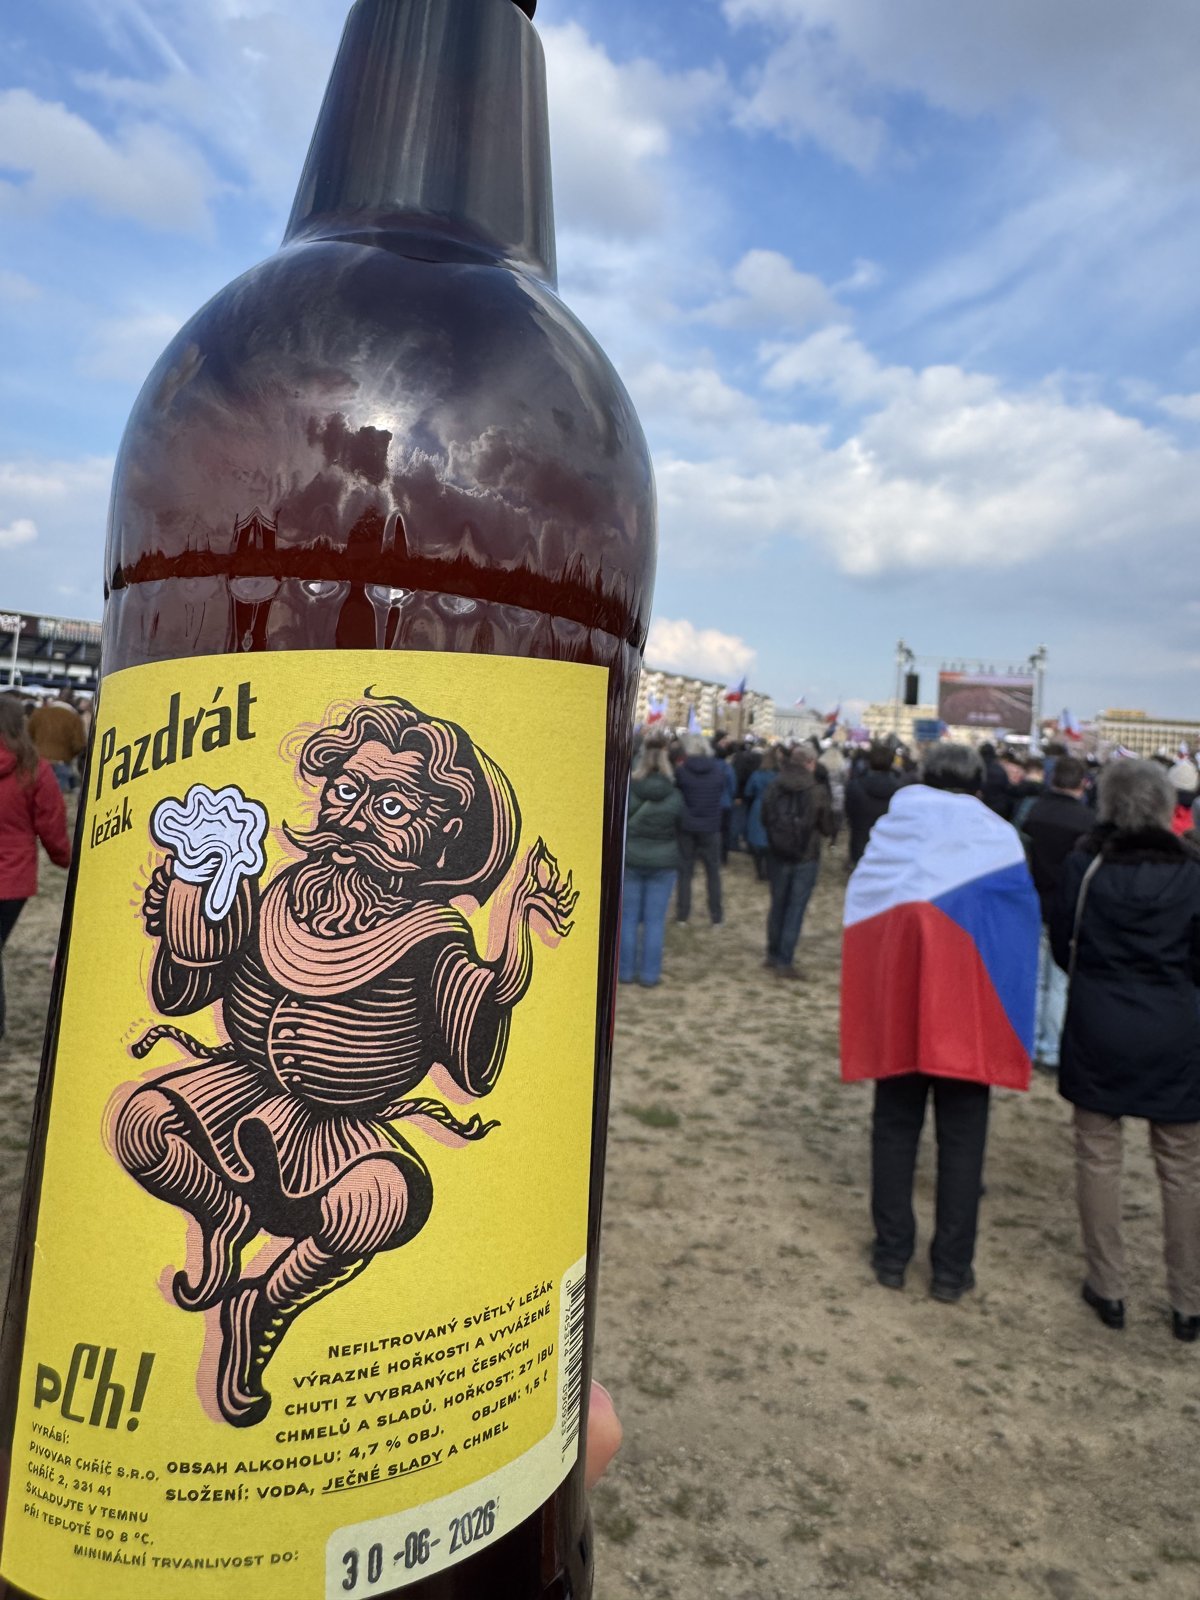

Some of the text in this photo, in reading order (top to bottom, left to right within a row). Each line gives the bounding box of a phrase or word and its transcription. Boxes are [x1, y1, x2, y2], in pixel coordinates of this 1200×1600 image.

[96, 681, 257, 800] Pazdrát
[90, 797, 133, 849] ležák
[293, 1300, 550, 1388] VÝRAZNÉ HOŘKOSTI A VYVÁŽENÉ
[328, 1280, 553, 1358] NEFILTROVANÝ SVĚTLÝ LEŽÁK
[275, 1344, 554, 1443] CHMELŮ A SLADŮ. HOŘKOST: 27 IBU
[285, 1339, 529, 1416] CHUTI Z VYBRANÝCH ČESKÝCH
[32, 1421, 70, 1444] VYRÁBÍ:
[167, 1461, 228, 1474] OBSAH
[234, 1450, 341, 1474] ALKOHOLU:
[349, 1442, 378, 1459] 4,7
[386, 1435, 401, 1452] %
[407, 1425, 444, 1444] OBJ.
[471, 1389, 521, 1421] OBJEM:
[525, 1377, 540, 1395] 1,5
[28, 1461, 112, 1496] CHŘÍČ 2, 331 41
[29, 1440, 159, 1482] PIVOVAR CHŘÍČ S.R.O.
[165, 1421, 509, 1501] SLOŽENÍ: VODA, JEČNÉ SLADY A CHMEL
[24, 1503, 40, 1519] PŘI
[42, 1511, 91, 1536] TEPLOTĚ
[96, 1528, 114, 1540] DO
[120, 1532, 128, 1542] 8
[26, 1481, 149, 1523] SKLADUJTE V TEMNU
[74, 1544, 299, 1569] MINIMÁLNÍ TRVANLIVOST DO:
